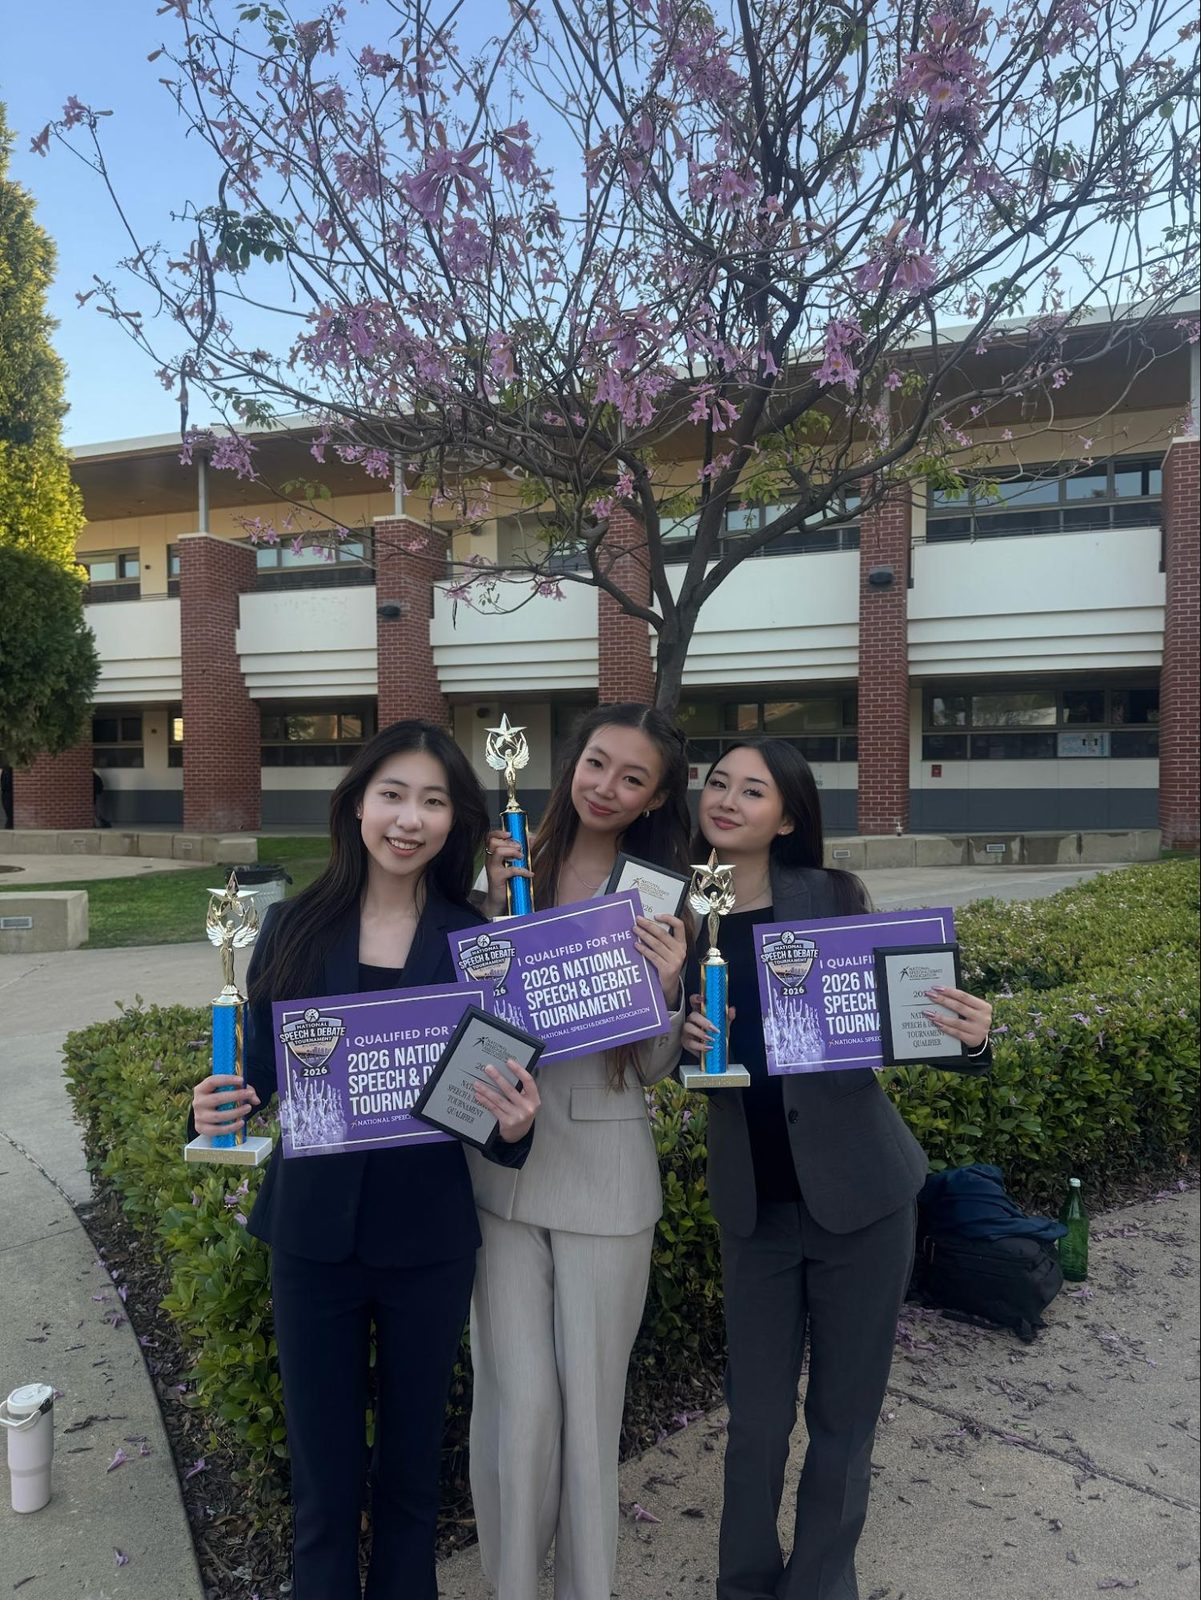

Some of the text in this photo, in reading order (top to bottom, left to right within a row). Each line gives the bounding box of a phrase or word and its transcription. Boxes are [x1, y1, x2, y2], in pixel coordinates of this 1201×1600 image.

[642, 904, 653, 912] 26
[472, 946, 499, 955] NATIONAL
[518, 930, 631, 966] I QUALIFIED FOR THE
[761, 949, 819, 962] SPEECH & DEBATE
[459, 954, 484, 969] SPEECH
[490, 948, 516, 959] DEBATE
[472, 959, 505, 970] TOURNAMENT
[820, 960, 823, 968] I
[522, 948, 631, 990] 2026 NATIONAL
[526, 965, 642, 1010] SPEECH & DEBATE
[783, 987, 804, 995] 2026
[822, 972, 860, 994] 2026
[494, 987, 506, 996] 26
[530, 989, 632, 1031] TOURNAMENT!
[824, 991, 876, 1014] SPEECH
[541, 1029, 570, 1040] NATIONAL
[570, 1024, 590, 1032] SPEECH
[595, 1017, 615, 1026] DEBATE
[615, 1007, 650, 1021] ASSOCIATION
[280, 1027, 346, 1042] SPEECH & DEBATE
[294, 1036, 332, 1045] TOURNAMENT
[346, 1038, 350, 1047] I
[354, 1029, 420, 1047] QUALIFIED
[425, 1026, 449, 1037] FOR
[834, 1038, 864, 1046] NATIONAL
[912, 1038, 942, 1048] QUALIFIER
[347, 1049, 390, 1073] 2026
[303, 1066, 328, 1076] 2026
[348, 1069, 406, 1094] SPEECH
[409, 1067, 420, 1086] &
[447, 1095, 484, 1117] TOURNAMENT
[357, 1113, 411, 1126] NATIONAL SPEEC
[447, 1106, 475, 1124] QUALIFIER
